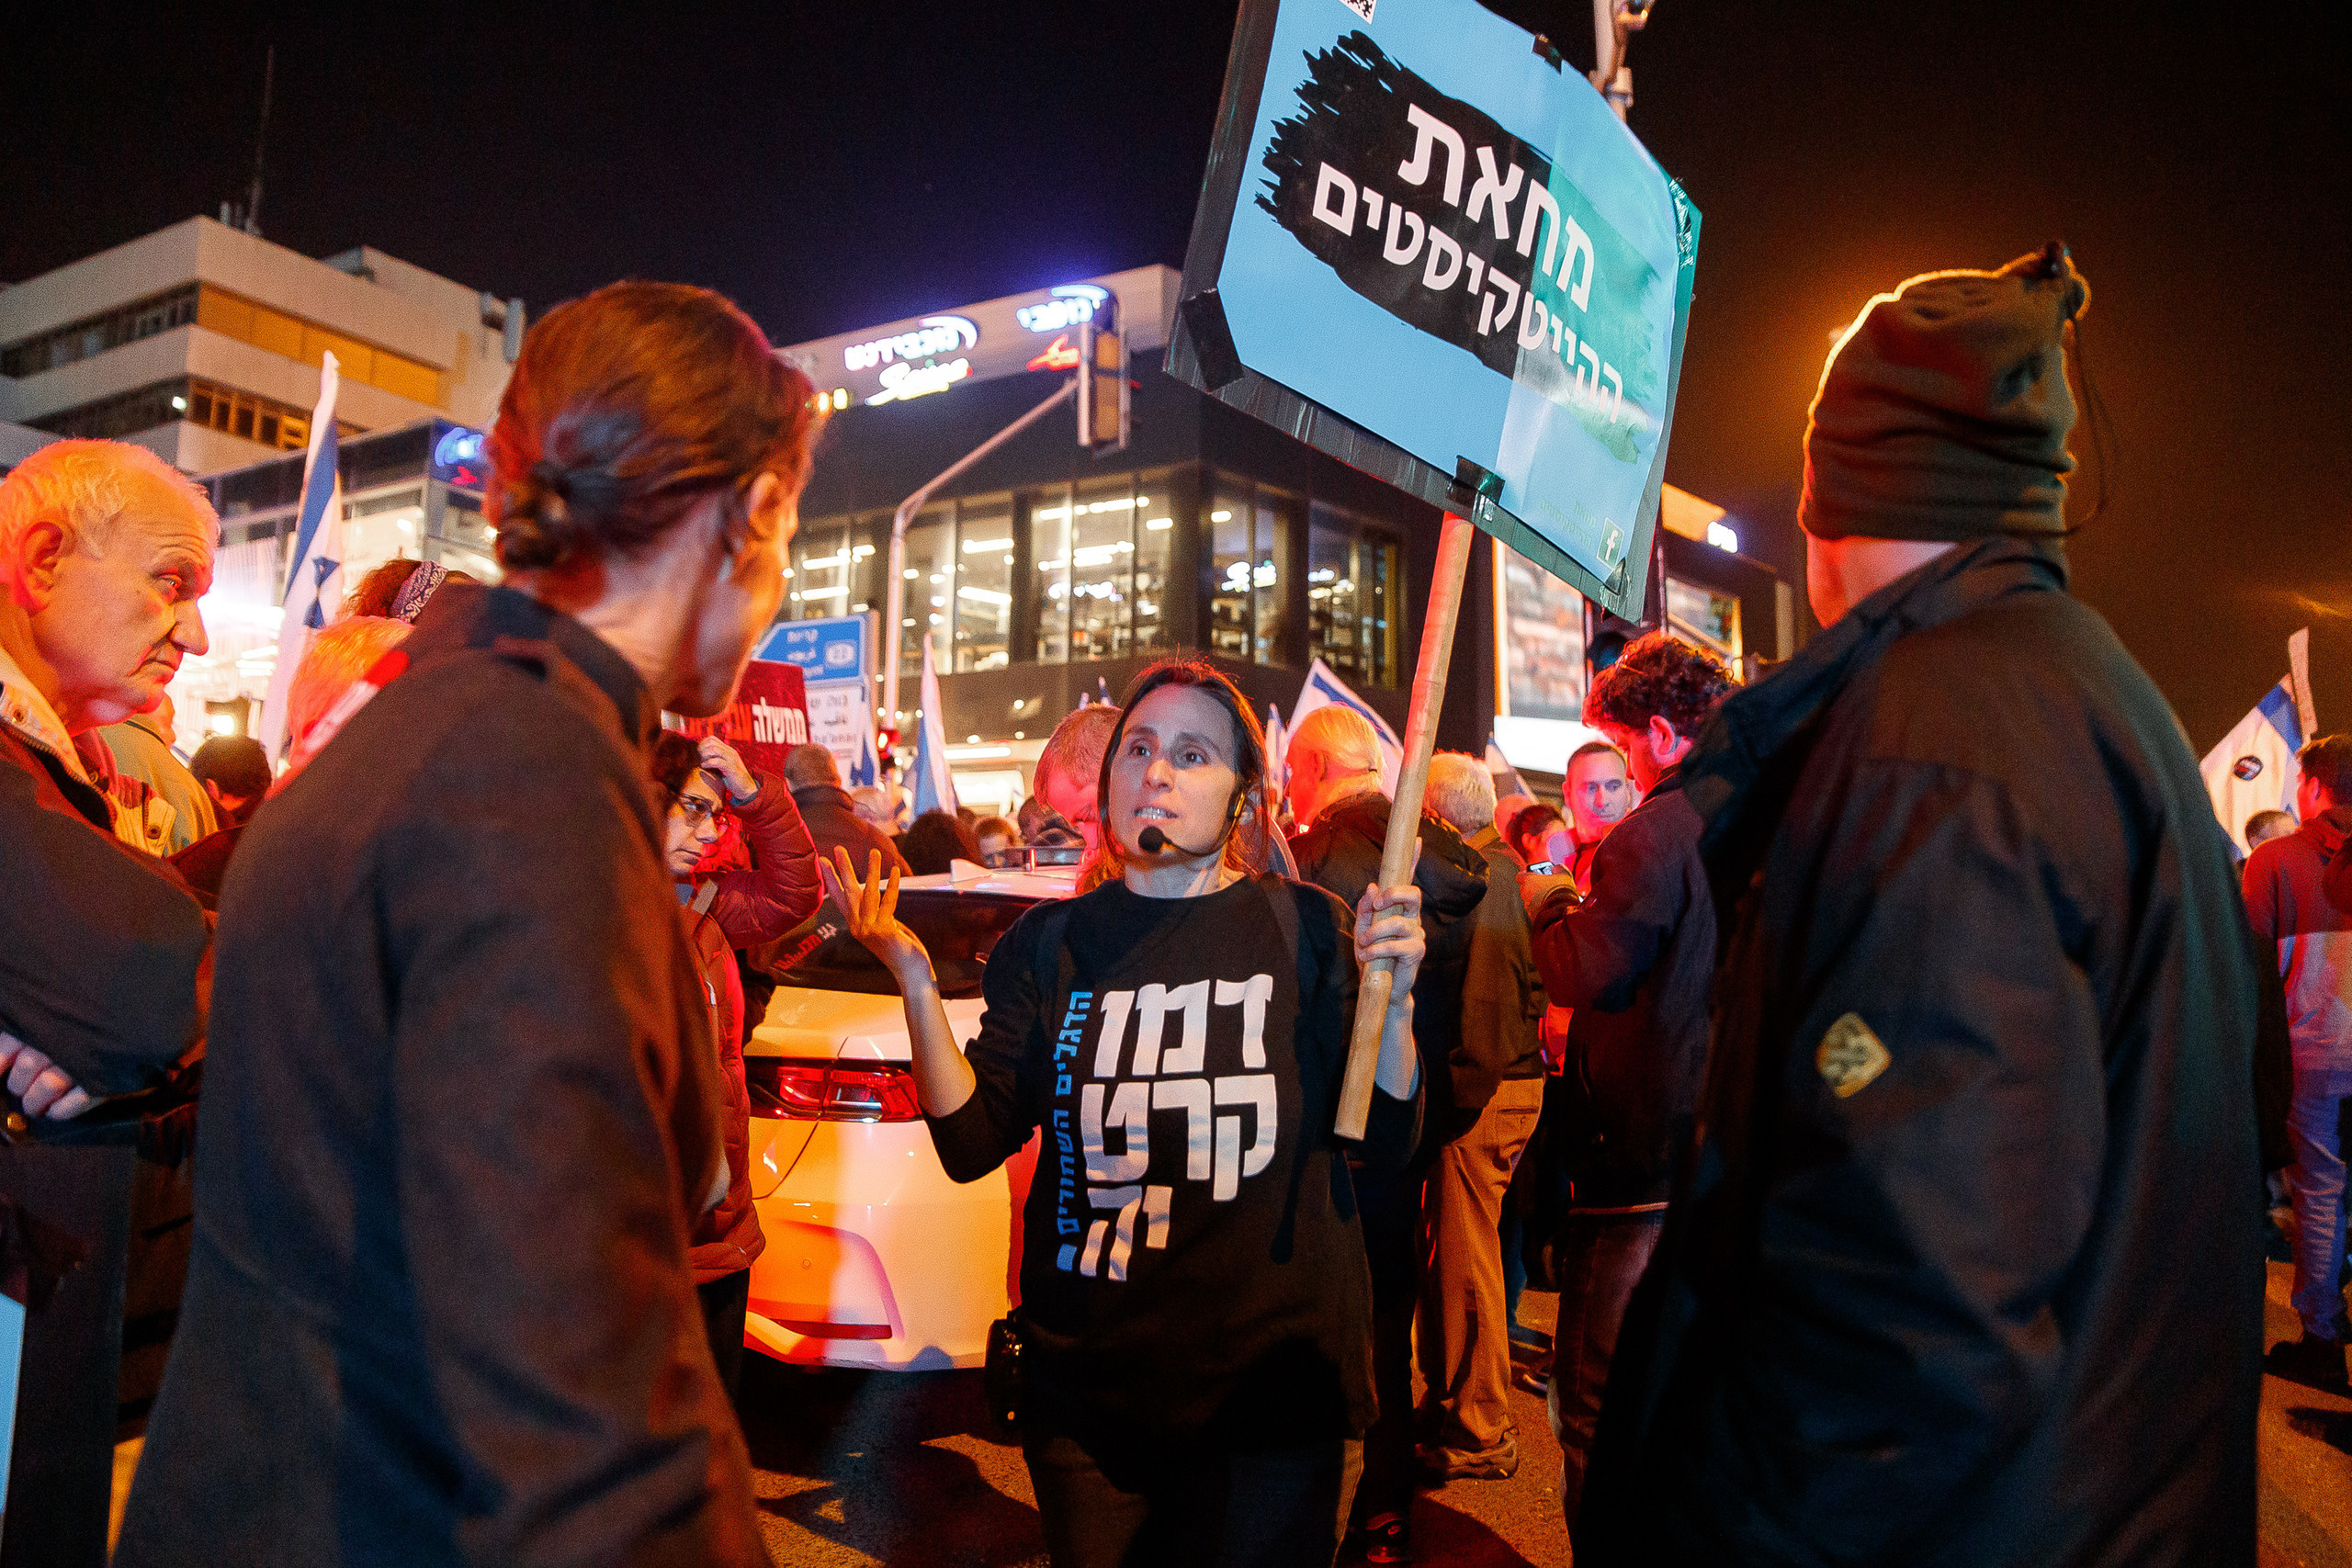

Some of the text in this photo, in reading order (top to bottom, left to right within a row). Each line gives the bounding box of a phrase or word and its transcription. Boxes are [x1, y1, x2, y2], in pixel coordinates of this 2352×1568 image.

[1312, 162, 1623, 422] ההייטקיסטים
[1398, 104, 1594, 312] מחאת
[752, 696, 808, 744] ממשלה
[1053, 991, 1093, 1235] הדגלים השחורים
